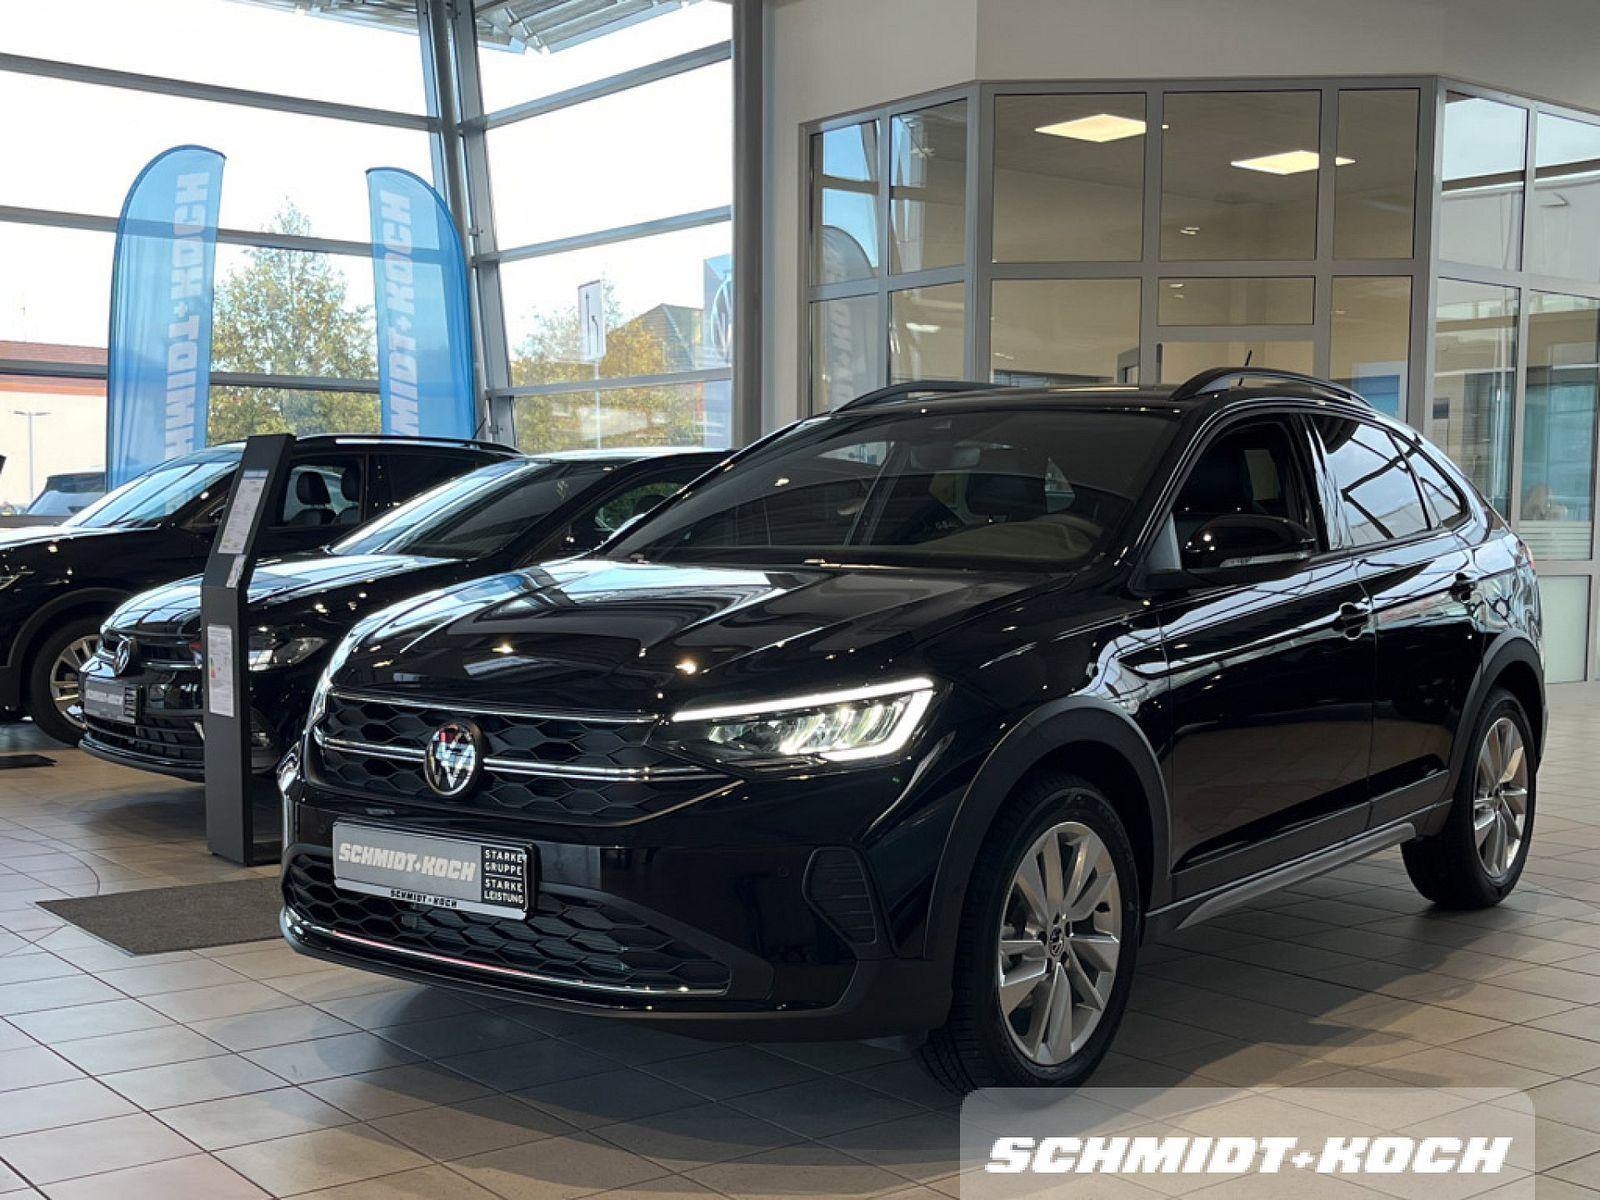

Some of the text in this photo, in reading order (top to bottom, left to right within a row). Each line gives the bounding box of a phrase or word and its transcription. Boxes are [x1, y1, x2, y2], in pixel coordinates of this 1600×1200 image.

[380, 189, 419, 436] MIDT+KOCH
[338, 842, 477, 882] SCHMIDT+KOCH
[485, 849, 523, 863] STARKE
[485, 878, 523, 893] STARKE
